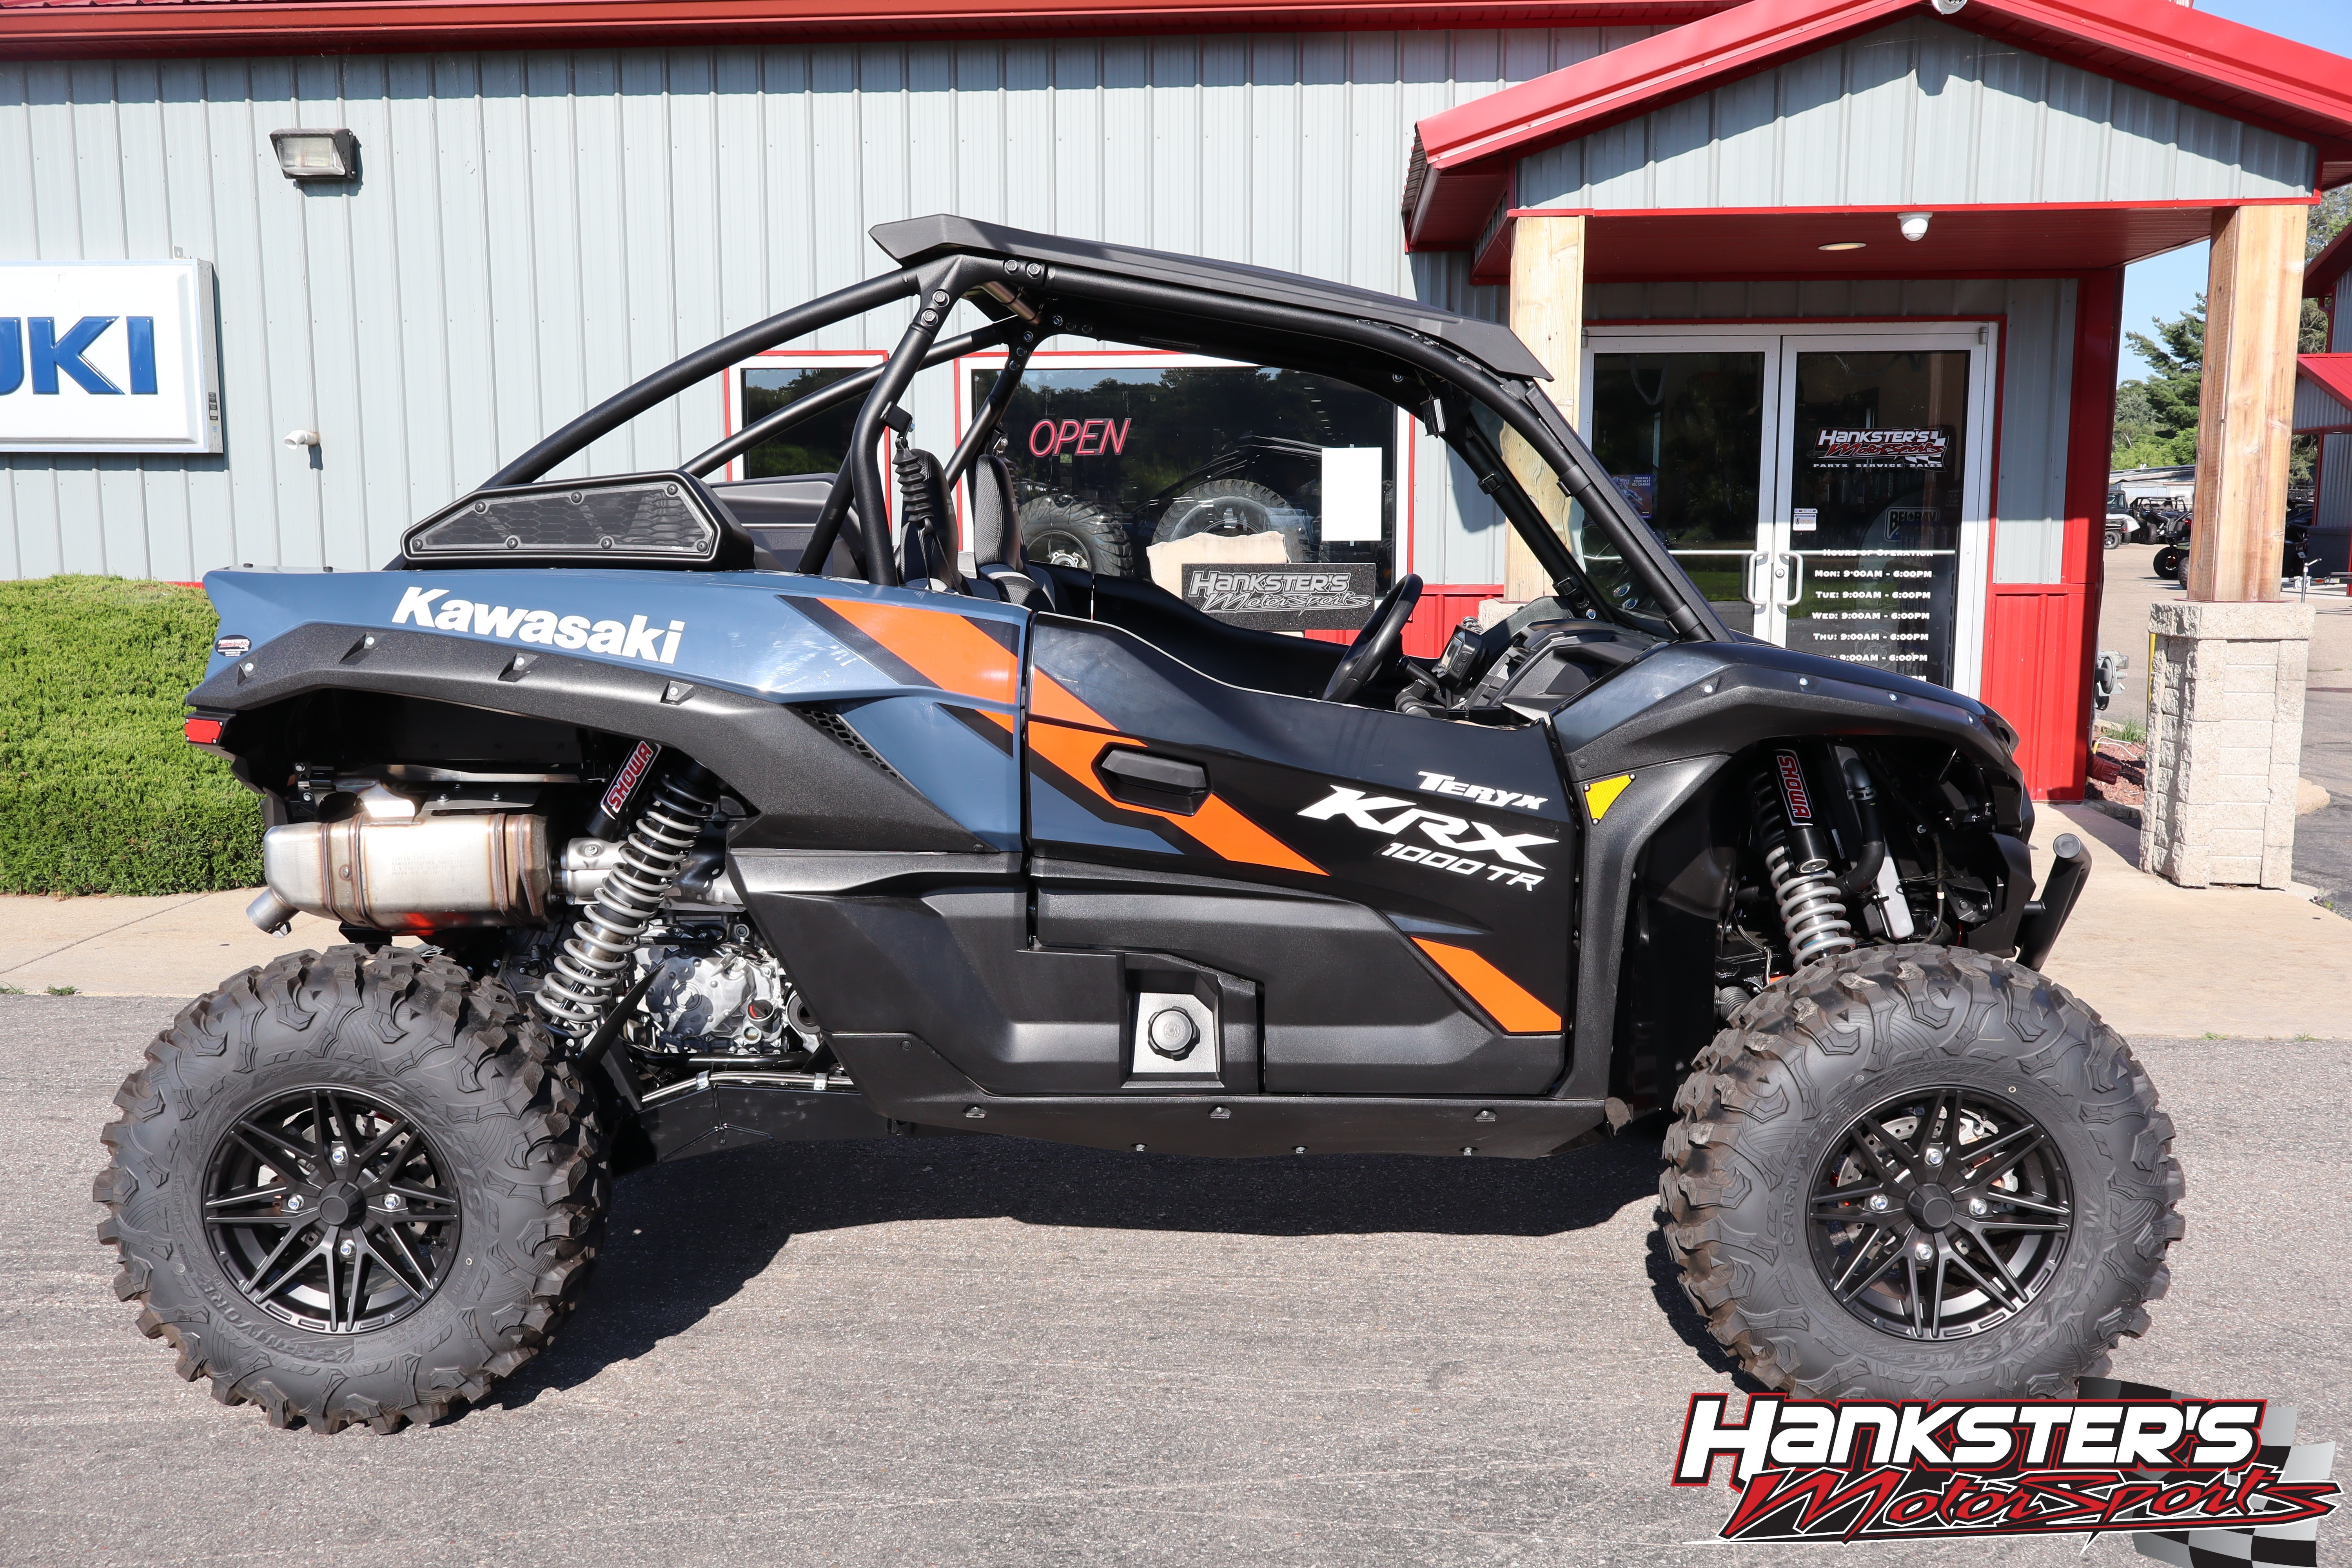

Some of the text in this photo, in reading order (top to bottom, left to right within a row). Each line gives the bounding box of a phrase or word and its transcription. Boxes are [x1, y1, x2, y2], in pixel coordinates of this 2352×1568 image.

[1029, 417, 1131, 457] OPEN
[392, 586, 685, 664] Kawasaki
[608, 740, 654, 812] SHOWA
[1417, 770, 1548, 809] TERYX
[1777, 755, 1811, 818] SHOWA
[1296, 784, 1560, 870] KRX
[1381, 842, 1544, 892] 1000 TR
